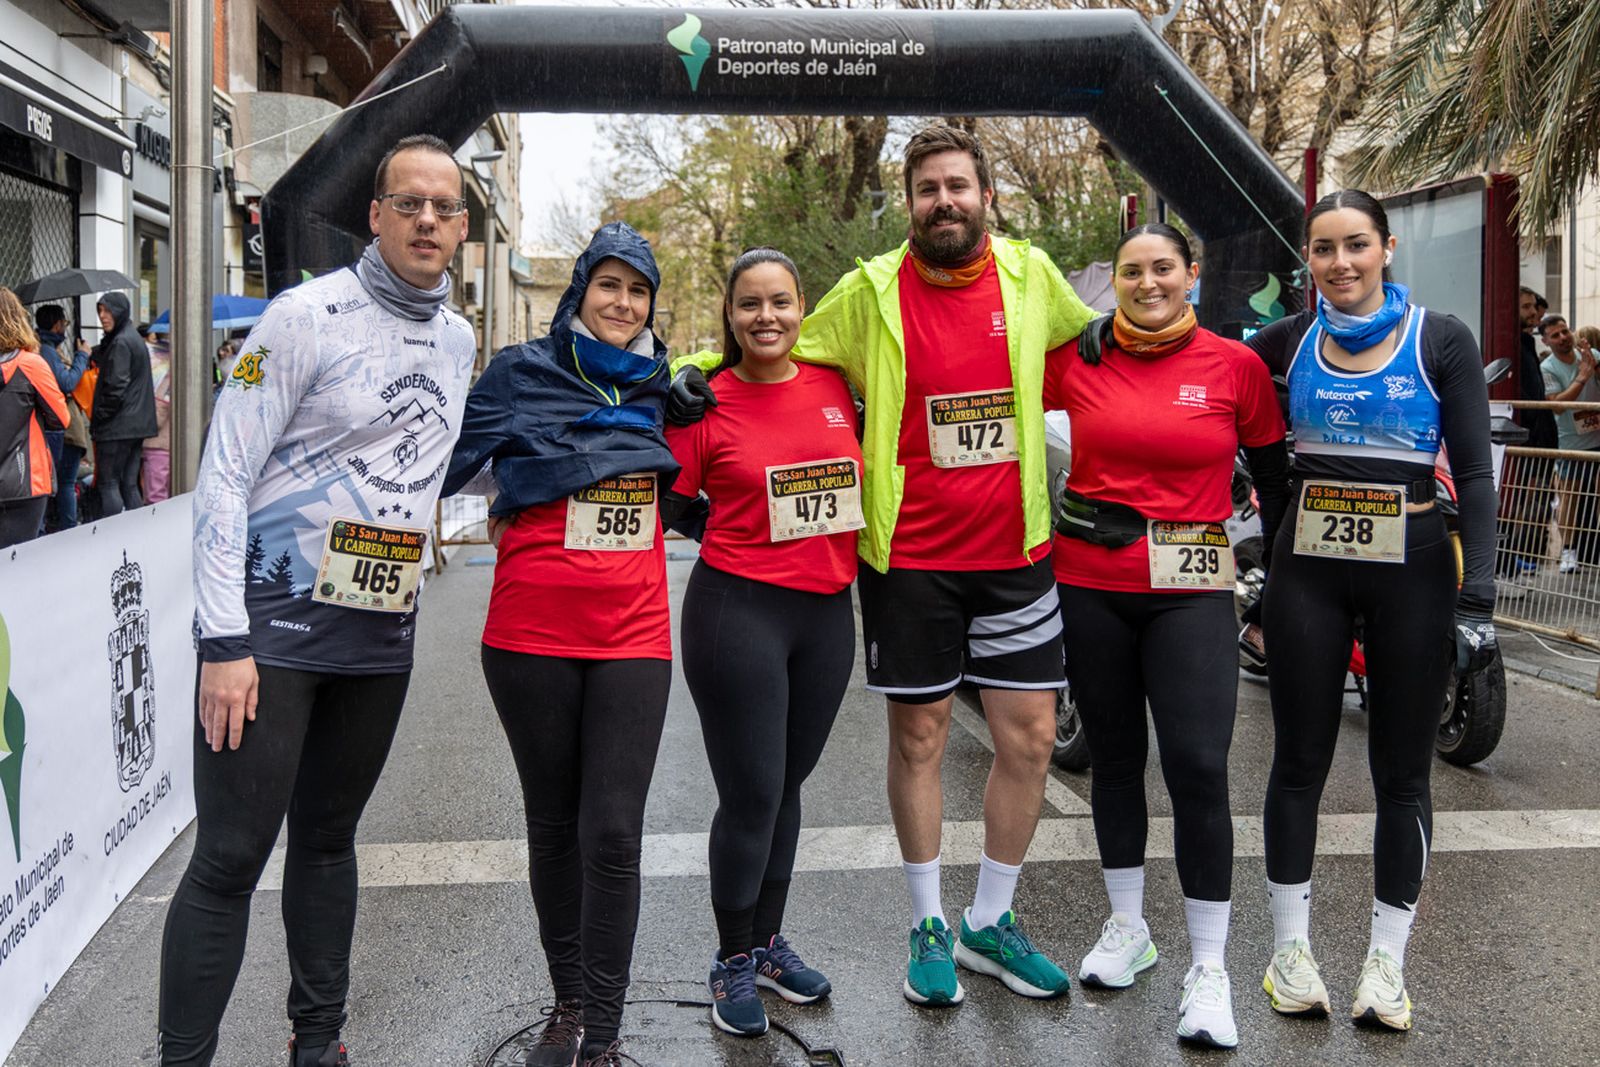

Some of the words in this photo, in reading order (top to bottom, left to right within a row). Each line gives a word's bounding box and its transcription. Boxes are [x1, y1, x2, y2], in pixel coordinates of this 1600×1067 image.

[717, 37, 805, 55] Patronato
[810, 38, 897, 57] Municipal
[901, 39, 925, 56] de
[717, 57, 800, 78] Deportes
[805, 58, 828, 76] de
[833, 58, 877, 76] Jaén
[380, 373, 448, 408] SENDERISMO
[1315, 388, 1355, 401] Nutesca
[952, 399, 969, 410] San
[970, 396, 991, 407] Juan
[935, 412, 942, 423] V
[944, 409, 983, 423] CARRERA
[958, 421, 1004, 452] 472
[617, 479, 637, 490] Juan
[775, 484, 782, 495] V
[783, 479, 818, 495] CARRERA
[819, 474, 854, 490] POPULAR
[790, 470, 805, 481] San
[806, 467, 826, 479] Juan
[586, 488, 628, 503] CARRERA
[1323, 487, 1340, 498] San
[1340, 488, 1365, 500] Juan
[1366, 490, 1396, 501] Bosco
[795, 492, 838, 523] 473
[1306, 497, 1313, 509] V
[1313, 498, 1352, 512] CARRERA
[1355, 501, 1398, 515] POPULAR
[596, 506, 642, 536] 585
[1321, 514, 1374, 545] 238
[358, 527, 378, 541] San
[379, 530, 402, 544] Juan
[402, 533, 420, 545] Bosc
[1155, 532, 1162, 543] V
[1165, 532, 1204, 544] CARRERA
[334, 536, 343, 550] V
[344, 538, 388, 558] CARRERA
[390, 545, 421, 560] POPULAR
[1178, 546, 1219, 574] 239
[351, 558, 404, 595] 465
[104, 806, 139, 857] CIUDAD
[139, 791, 151, 821] DE
[152, 770, 172, 809] JAÉN
[15, 838, 61, 906] Municipal
[62, 831, 74, 857] de
[0, 917, 26, 967] ortes
[28, 900, 41, 929] de
[42, 874, 65, 913] Jaén
